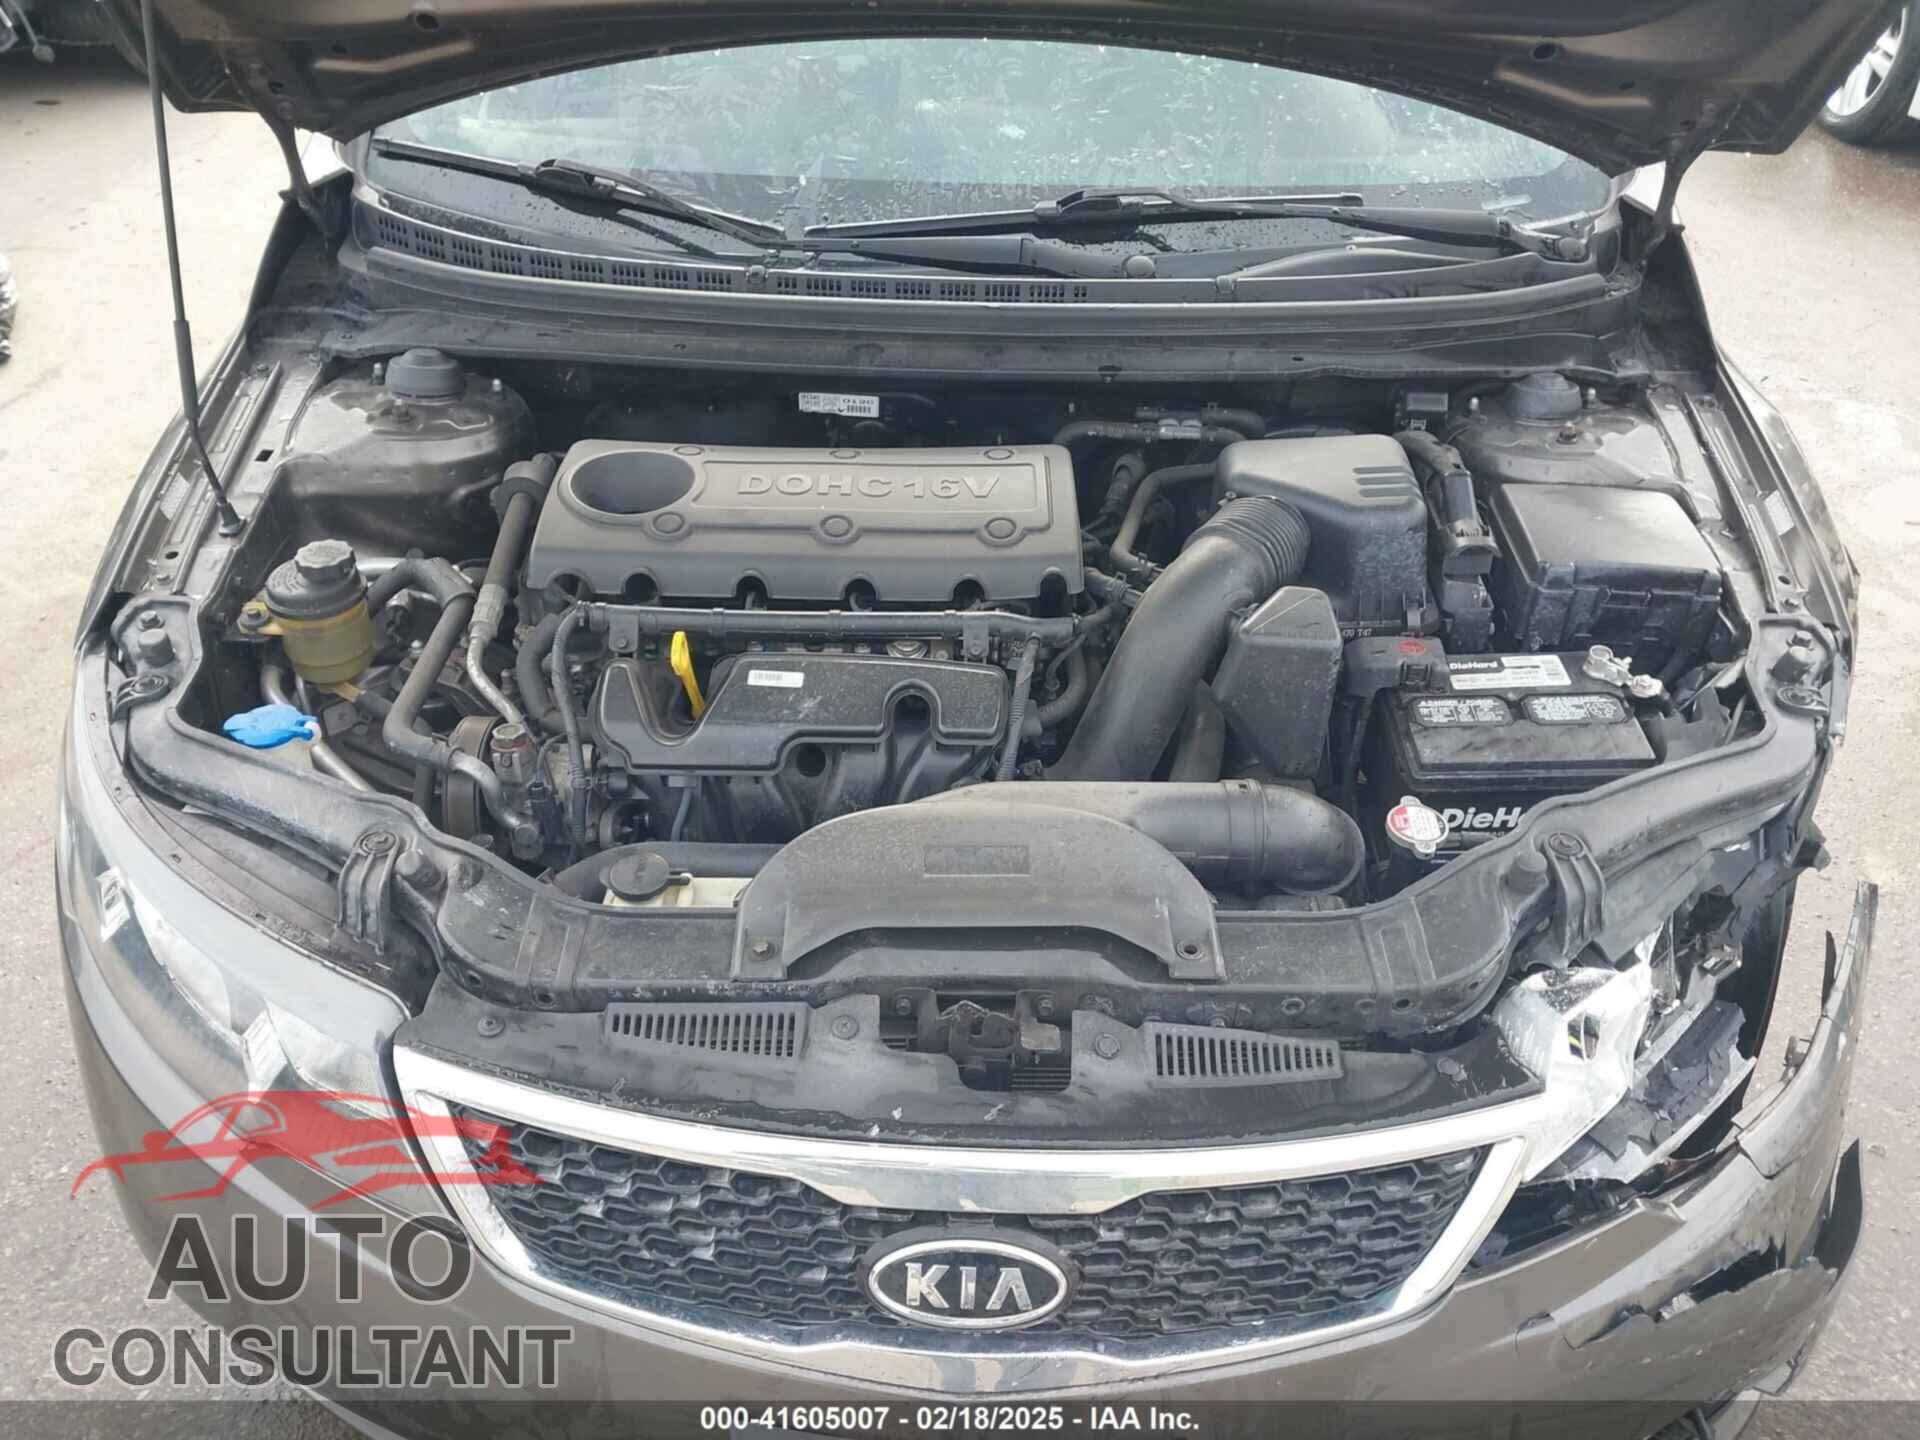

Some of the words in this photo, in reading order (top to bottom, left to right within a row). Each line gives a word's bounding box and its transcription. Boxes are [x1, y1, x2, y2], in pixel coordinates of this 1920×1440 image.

[737, 473, 895, 498] DOHC
[903, 475, 1000, 498] 16V
[1449, 661, 1498, 670] DieHard
[1442, 806, 1524, 829] DieH
[905, 1262, 1033, 1310] KIA
